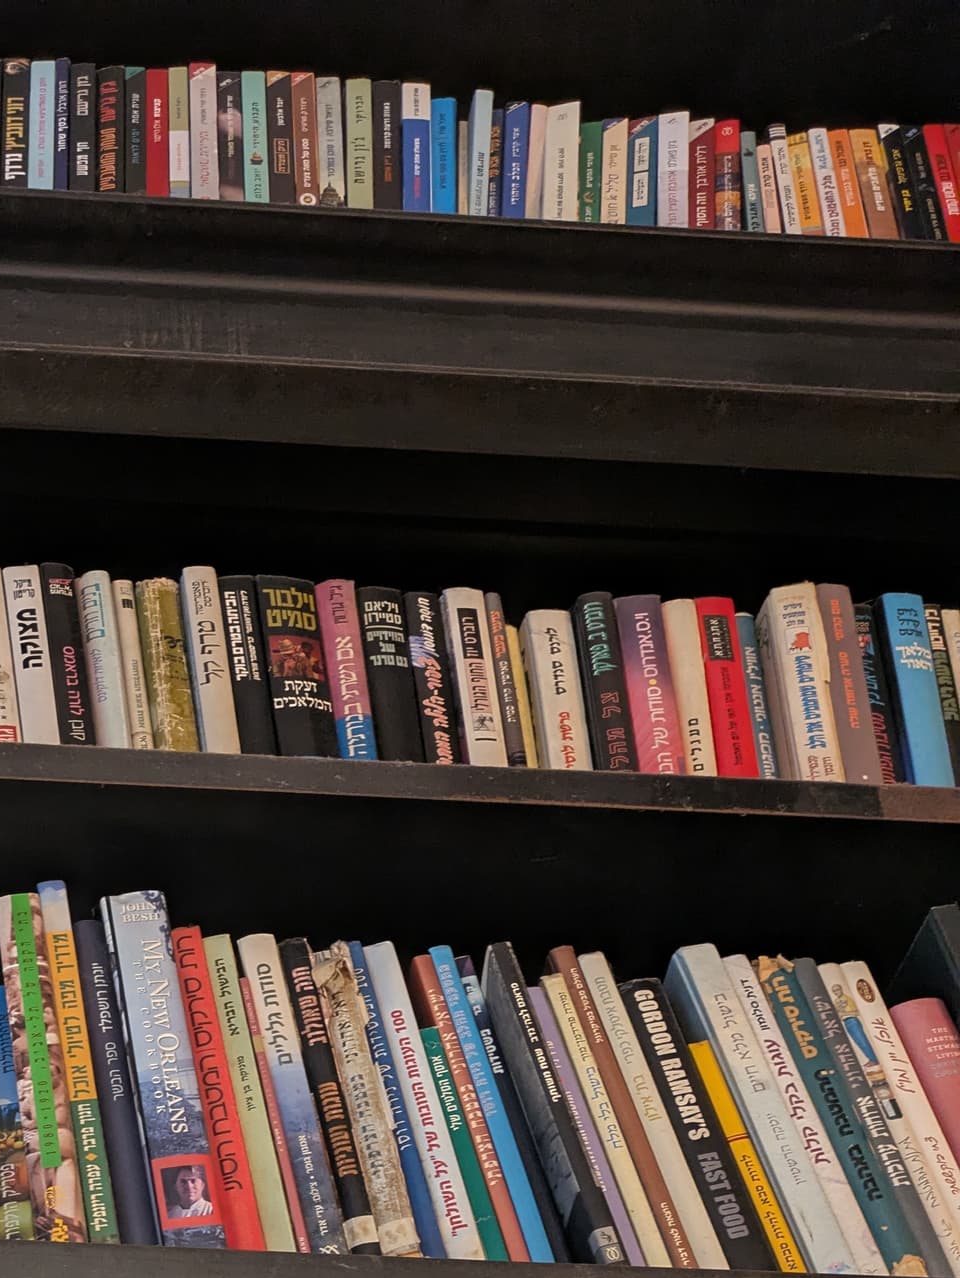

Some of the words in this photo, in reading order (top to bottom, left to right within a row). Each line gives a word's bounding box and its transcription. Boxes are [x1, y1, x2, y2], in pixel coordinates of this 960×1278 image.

[224, 591, 239, 623] הביתה
[263, 587, 316, 612] וילבור
[365, 601, 399, 613] ויליאם
[266, 609, 317, 631] סמיט
[364, 613, 402, 625] סטיירון
[17, 607, 43, 671] מצוקה
[198, 621, 219, 655] טרף
[229, 626, 243, 654] בטרם
[336, 636, 353, 661] אם
[544, 628, 561, 655] לורנס
[200, 660, 224, 686] קל
[233, 656, 248, 681] בוקר
[339, 663, 359, 698] ושתי
[552, 661, 567, 694] סנדרס
[284, 680, 317, 692] זעקת
[274, 696, 333, 713] המלאכים
[647, 687, 662, 722] סודות
[344, 702, 368, 757] בנותיה
[652, 727, 668, 750] של
[688, 718, 704, 772] מעגלים
[120, 902, 157, 913] JOHN
[121, 912, 160, 923] BESH
[54, 932, 70, 974] מדריך
[176, 935, 197, 969] רות
[59, 980, 77, 1010] מפה
[215, 958, 229, 998] הבישול
[257, 963, 278, 1006] סודות
[183, 977, 212, 1047] סירקיס
[221, 1001, 239, 1036] הבריא
[390, 1010, 407, 1034] 100
[63, 1017, 83, 1060] לטיולי
[264, 1009, 293, 1065] גליליים
[399, 1036, 420, 1078] העוגות
[633, 989, 676, 1056] GORDON
[661, 1056, 710, 1142] RAMSAY'S
[70, 1064, 89, 1099] אוכל
[200, 1057, 231, 1136] המטבח
[409, 1080, 434, 1127] הטובות
[424, 1130, 440, 1154] של
[218, 1140, 242, 1191] הסיני
[697, 1151, 730, 1192] FAST
[713, 1193, 750, 1240] FOOD
